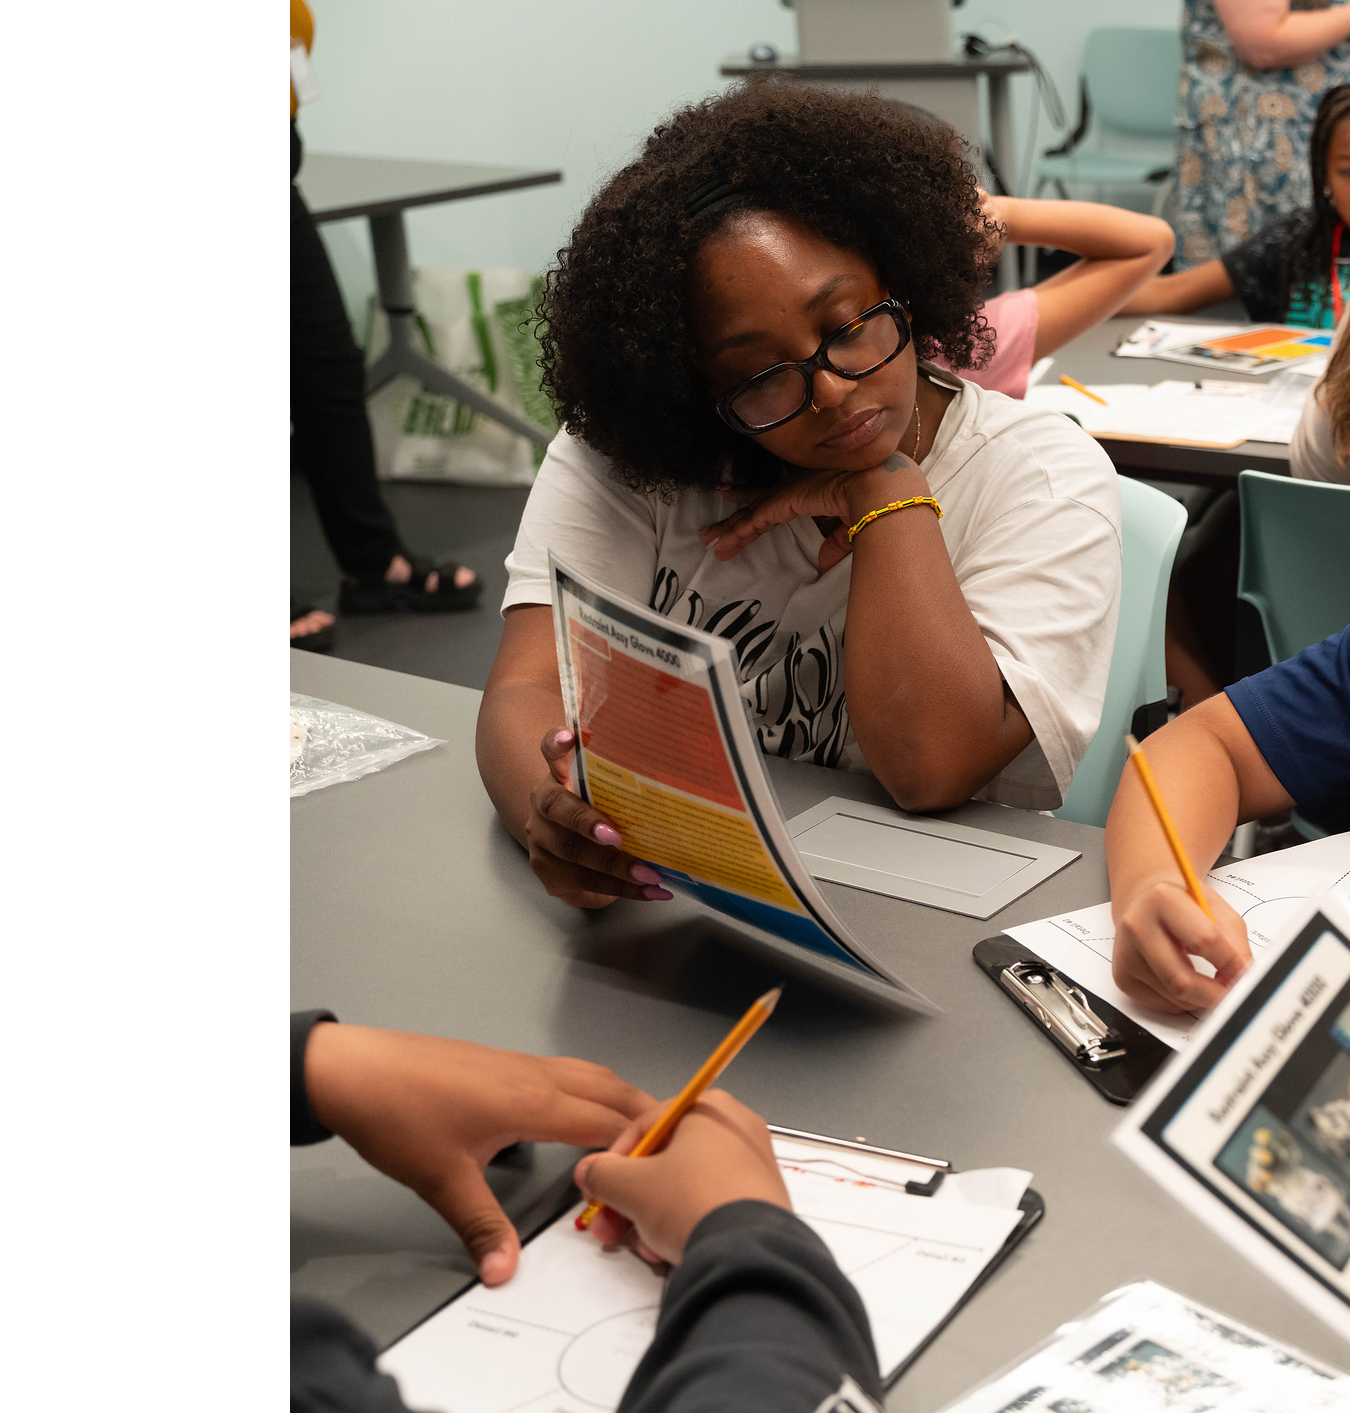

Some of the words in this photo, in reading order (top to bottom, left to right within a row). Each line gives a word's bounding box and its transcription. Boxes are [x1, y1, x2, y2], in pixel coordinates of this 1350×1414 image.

[578, 606, 611, 636] Restraint
[611, 625, 629, 648] Assy
[630, 634, 655, 658] Glove
[1069, 922, 1091, 935] Detail
